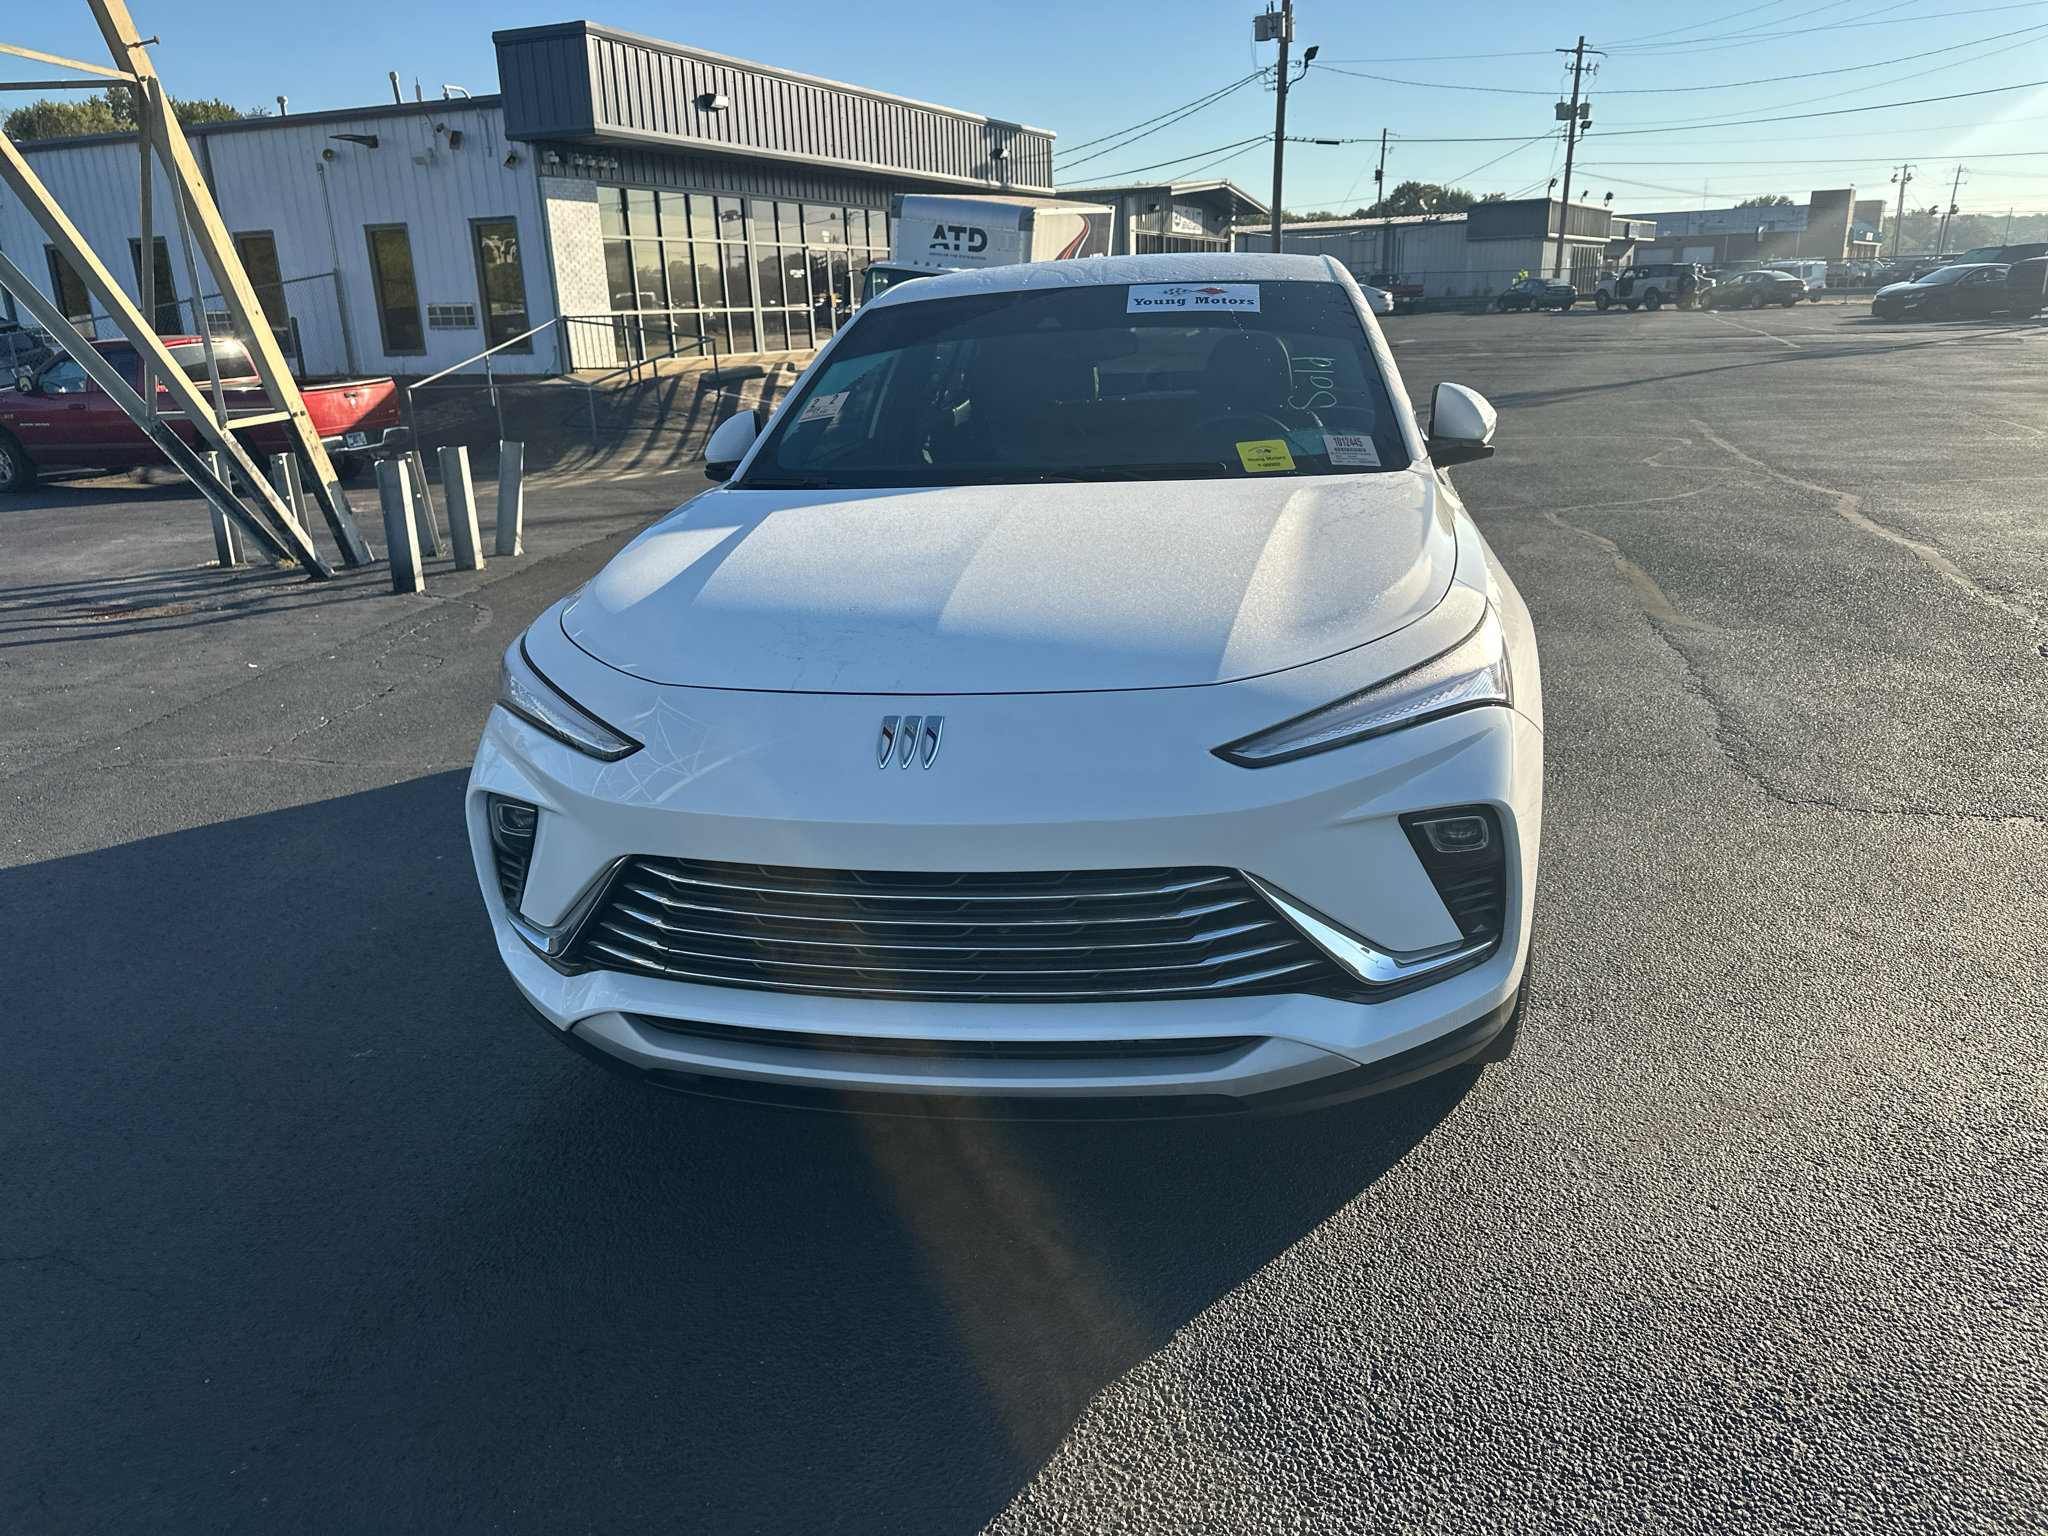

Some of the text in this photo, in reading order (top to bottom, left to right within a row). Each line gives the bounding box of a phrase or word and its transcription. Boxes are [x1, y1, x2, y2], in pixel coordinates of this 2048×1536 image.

[929, 224, 988, 253] ATD
[1133, 296, 1255, 306] Young Motors
[1287, 356, 1338, 410] Sold
[1333, 437, 1364, 448] 1012445
